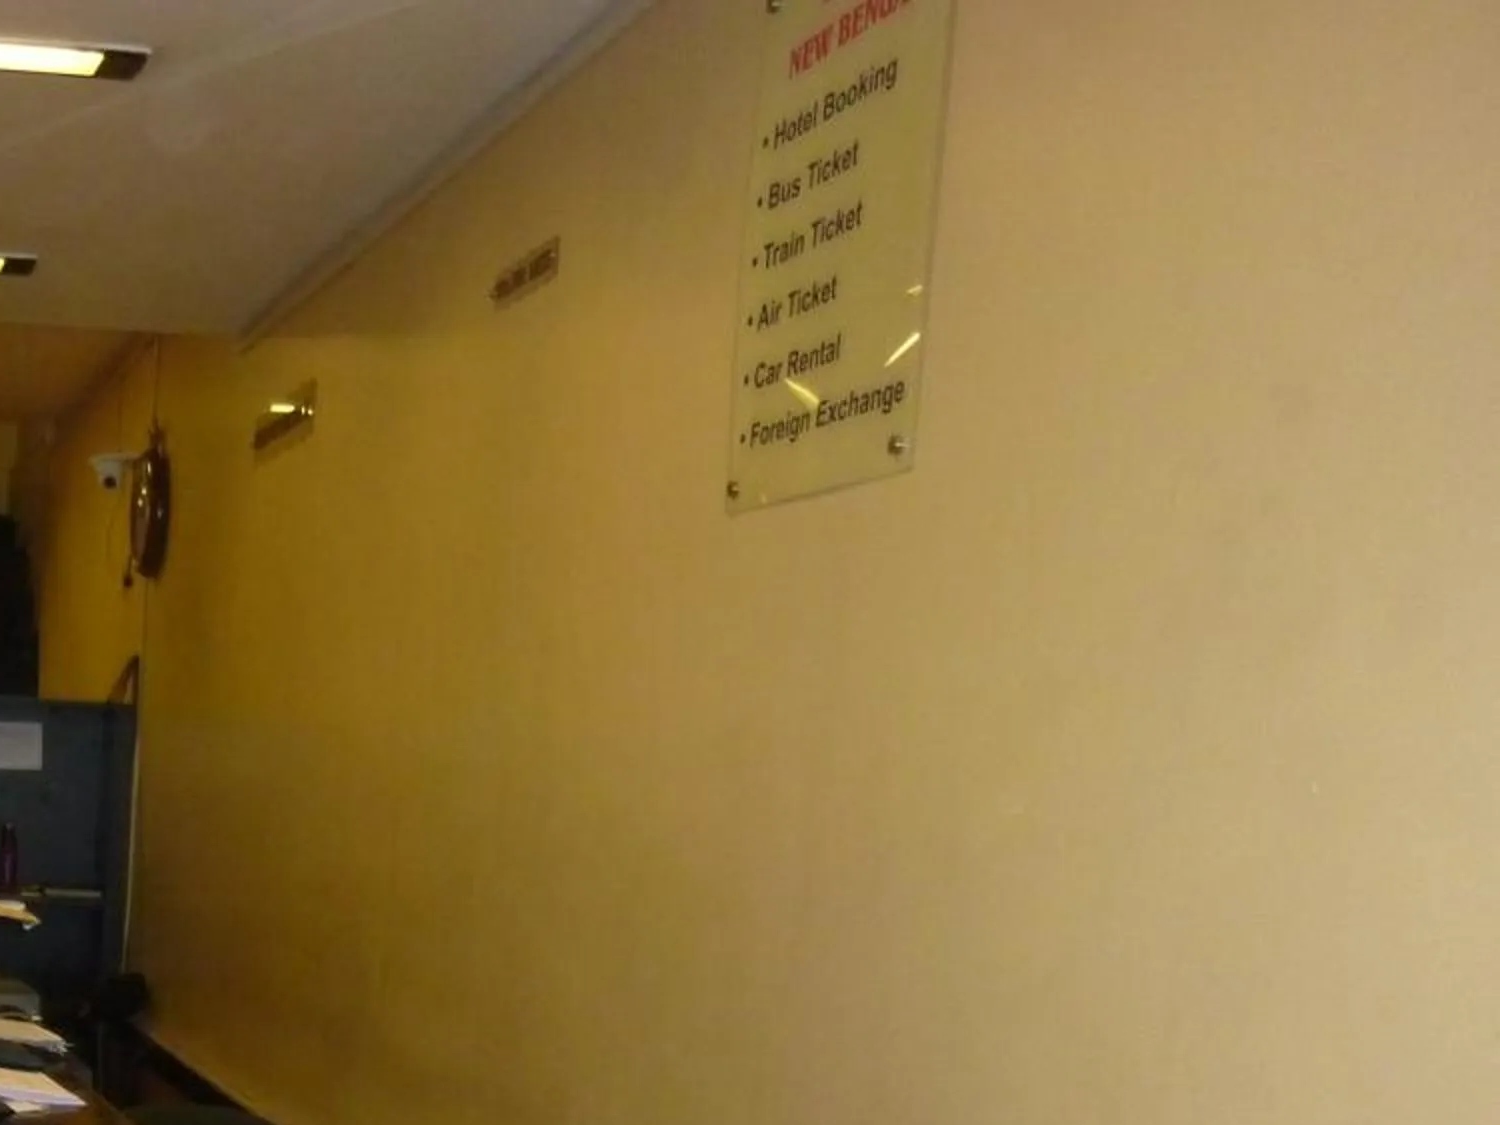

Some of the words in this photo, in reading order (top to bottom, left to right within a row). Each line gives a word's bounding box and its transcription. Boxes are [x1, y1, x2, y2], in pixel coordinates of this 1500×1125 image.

[789, 23, 833, 79] NEW
[773, 101, 819, 150] Hotel
[822, 58, 899, 123] Booking
[767, 177, 802, 210] Bus
[806, 142, 860, 190] Ticket
[763, 231, 806, 269] Train
[810, 200, 863, 249] Ticket
[756, 298, 783, 331] Air
[788, 276, 838, 318] Ticket
[753, 361, 783, 388] Car
[786, 333, 842, 377] Rental
[749, 407, 811, 448] Foreign
[815, 380, 906, 428] Exchange
